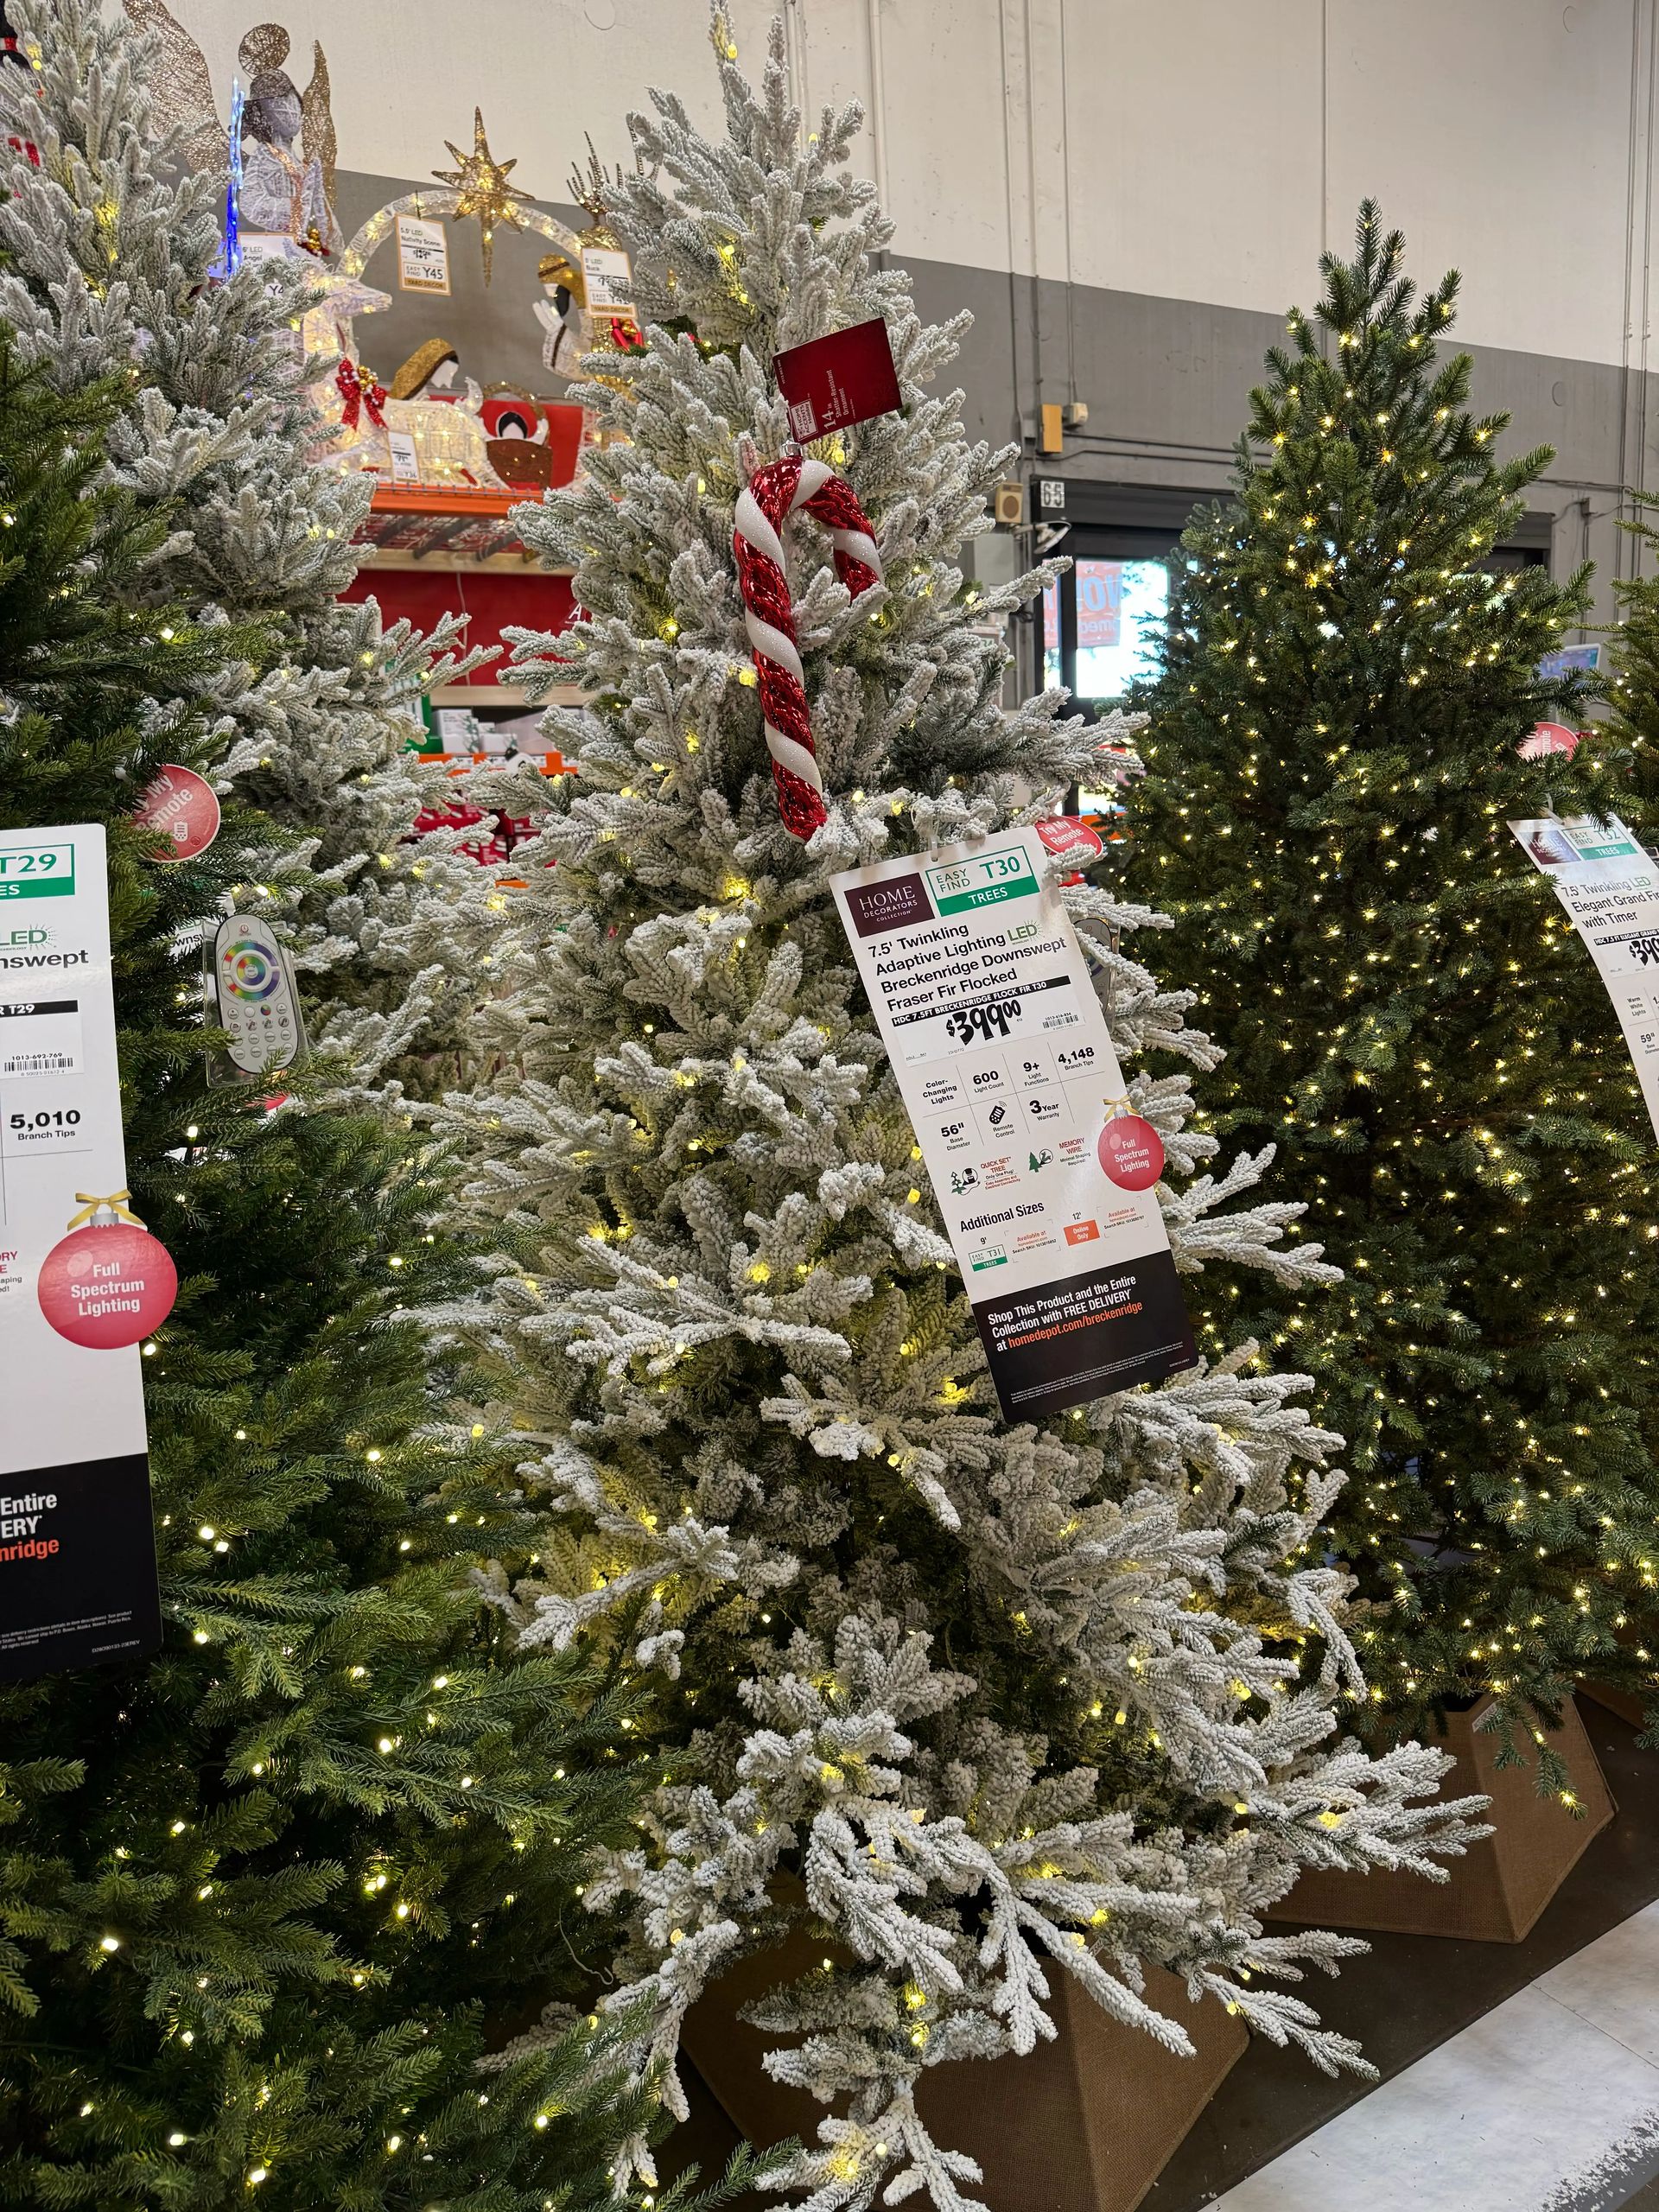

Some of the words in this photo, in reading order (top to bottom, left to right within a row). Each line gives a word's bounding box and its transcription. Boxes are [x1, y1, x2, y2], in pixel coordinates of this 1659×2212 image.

[422, 266, 443, 280] Y45
[826, 370, 842, 418] Shatter-Resistant
[838, 388, 849, 416] Ornament
[822, 410, 836, 429] 14
[1043, 482, 1064, 506] 65
[1038, 825, 1058, 836] Try
[1052, 820, 1071, 830] My
[1048, 828, 1084, 846] Remote
[1594, 847, 1620, 856] TREES
[936, 868, 967, 884] EASY
[979, 856, 1020, 879] T30
[940, 878, 970, 893] FIND
[1560, 885, 1580, 898] 7.5'
[1580, 878, 1633, 895] Twinkling
[1629, 876, 1651, 888] LED
[859, 886, 915, 911] HOME
[968, 887, 1008, 905] TREES
[864, 899, 918, 918] DECORATORS
[1571, 899, 1614, 916] Elegant
[1614, 893, 1647, 906] Grand
[1582, 915, 1605, 929] with
[1605, 911, 1638, 925] Timer
[868, 941, 893, 958] 7.5'
[897, 925, 969, 950] Twinkling
[875, 950, 942, 976] Adaptive
[944, 933, 1006, 958] Lighting
[1007, 924, 1038, 943] LED
[880, 960, 979, 994] Breckenridge
[982, 937, 1067, 968] Downswept
[887, 989, 934, 1012] Fraser
[937, 984, 957, 999] Fir
[959, 968, 1018, 993] Flocked
[9, 1004, 35, 1014] T29
[893, 1014, 912, 1026] HDC
[912, 1008, 934, 1021] 7.5FT
[935, 995, 992, 1014] BRECKENRIDGE
[993, 988, 1018, 1001] FLOCK
[1019, 985, 1032, 995] FIR
[1032, 982, 1047, 991] T30
[1640, 1033, 1656, 1044] 59"
[12, 1052, 63, 1061] 1013-692-769
[1058, 1046, 1095, 1065] 4,148
[1023, 1062, 1040, 1072] 9+
[1064, 1062, 1083, 1071] Branch
[1083, 1059, 1094, 1068] Tips
[972, 1071, 999, 1085] 600
[1024, 1077, 1050, 1087] Functions
[1027, 1071, 1042, 1080] Light
[922, 1084, 957, 1098] Changing
[925, 1079, 949, 1089] Color-
[974, 1085, 988, 1094] Light
[988, 1081, 1005, 1090] Count
[931, 1094, 955, 1105] Lights
[1029, 1100, 1042, 1115] 3
[1042, 1102, 1059, 1113] Year
[10, 1109, 81, 1131] 5,010
[1036, 1111, 1060, 1122] Warranty
[17, 1131, 53, 1141] Branch
[54, 1129, 76, 1140] Tips
[940, 1122, 965, 1138] 56"
[992, 1123, 1014, 1133] Remote
[995, 1129, 1015, 1139] Control
[946, 1141, 970, 1151] Diameter
[950, 1136, 963, 1145] Base
[1058, 1137, 1084, 1149] MEMORY
[1122, 1139, 1136, 1149] Full
[1065, 1146, 1083, 1154] WIRE
[1114, 1147, 1150, 1164] Spectrum
[980, 1160, 998, 1169] QUICK
[990, 1165, 1006, 1173] TREE
[1120, 1159, 1150, 1173] Lighting
[960, 1208, 1014, 1232] Additional
[1016, 1202, 1045, 1217] Sizes
[1072, 1211, 1082, 1220] 12'
[1108, 1208, 1129, 1218] Available
[1017, 1232, 1039, 1243] Available
[1072, 1226, 1089, 1235] Online
[987, 1248, 1001, 1258] T31
[92, 1262, 120, 1278] Full
[71, 1280, 145, 1300] Spectrum
[988, 1310, 1014, 1325] Shop
[1014, 1303, 1036, 1319] This
[1037, 1292, 1074, 1312] Product
[1075, 1287, 1093, 1302] and
[1093, 1282, 1109, 1296] the
[1109, 1274, 1136, 1294] Entire
[78, 1299, 141, 1317] Lighting
[992, 1316, 1040, 1338] Collection
[1040, 1309, 1063, 1325] with
[1064, 1303, 1088, 1319] FREE
[995, 1338, 1008, 1352] at
[1008, 1300, 1143, 1350] homedepot.com/breckenridge
[0, 1493, 58, 1516] Entire
